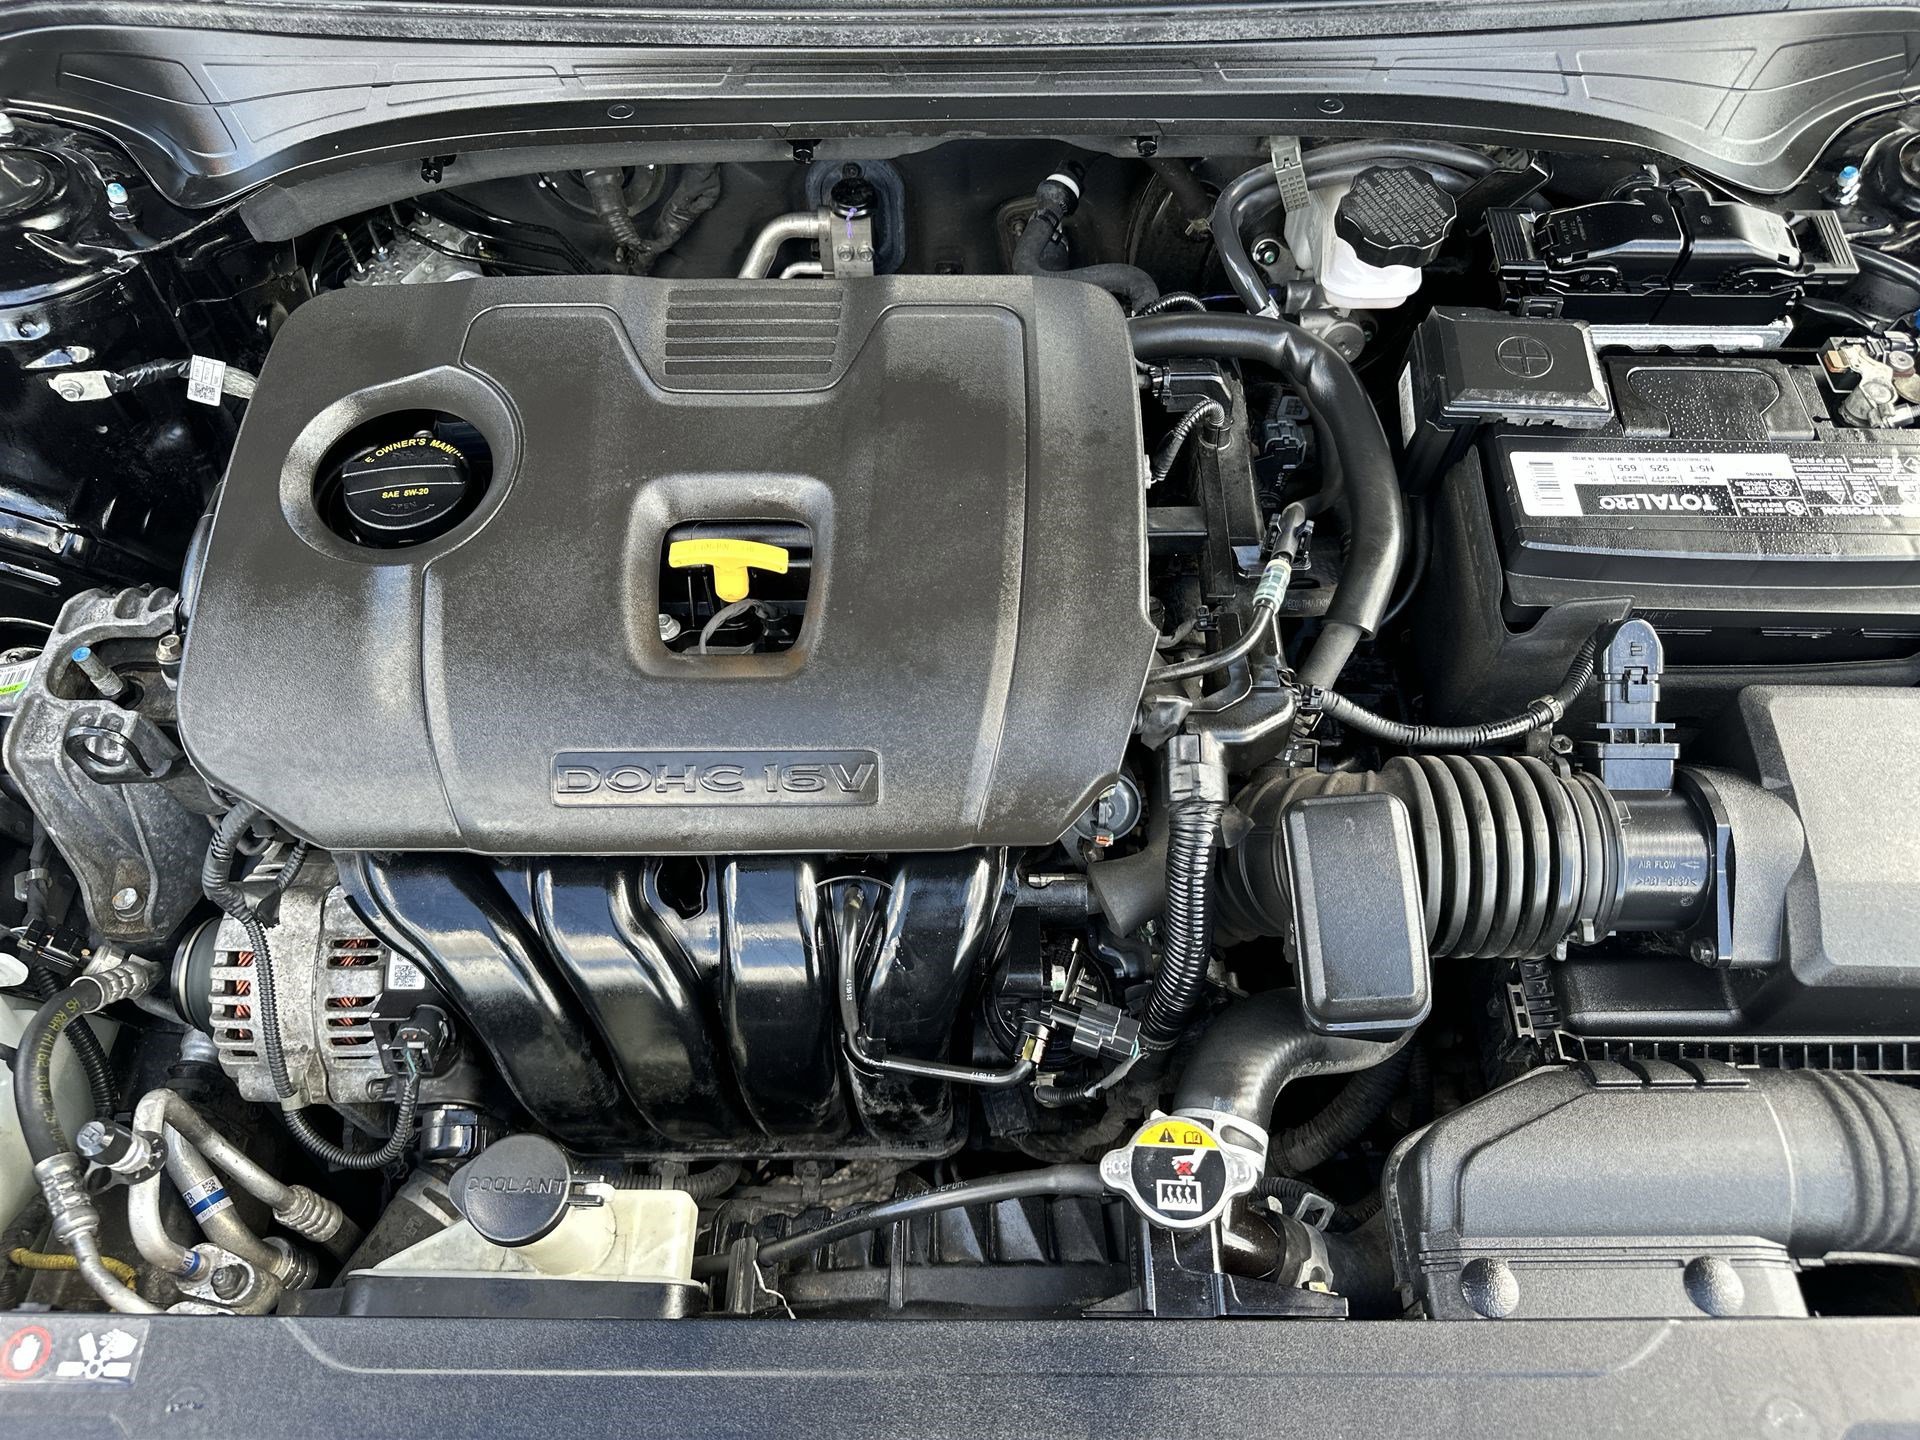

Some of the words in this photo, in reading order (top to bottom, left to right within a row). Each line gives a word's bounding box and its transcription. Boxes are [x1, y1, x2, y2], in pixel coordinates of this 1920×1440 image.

[375, 438, 427, 457] OWNER'S
[1617, 464, 1637, 472] 655
[1650, 464, 1670, 472] 525
[381, 490, 400, 499] SAE
[403, 487, 430, 497] 5W-20
[1598, 493, 1719, 511] TOTALPRO
[556, 764, 746, 794] DOHC
[763, 763, 876, 793] 16V
[1638, 860, 1652, 870] AIR
[1654, 860, 1677, 870] FLOW
[467, 1176, 566, 1195] COOLANT
